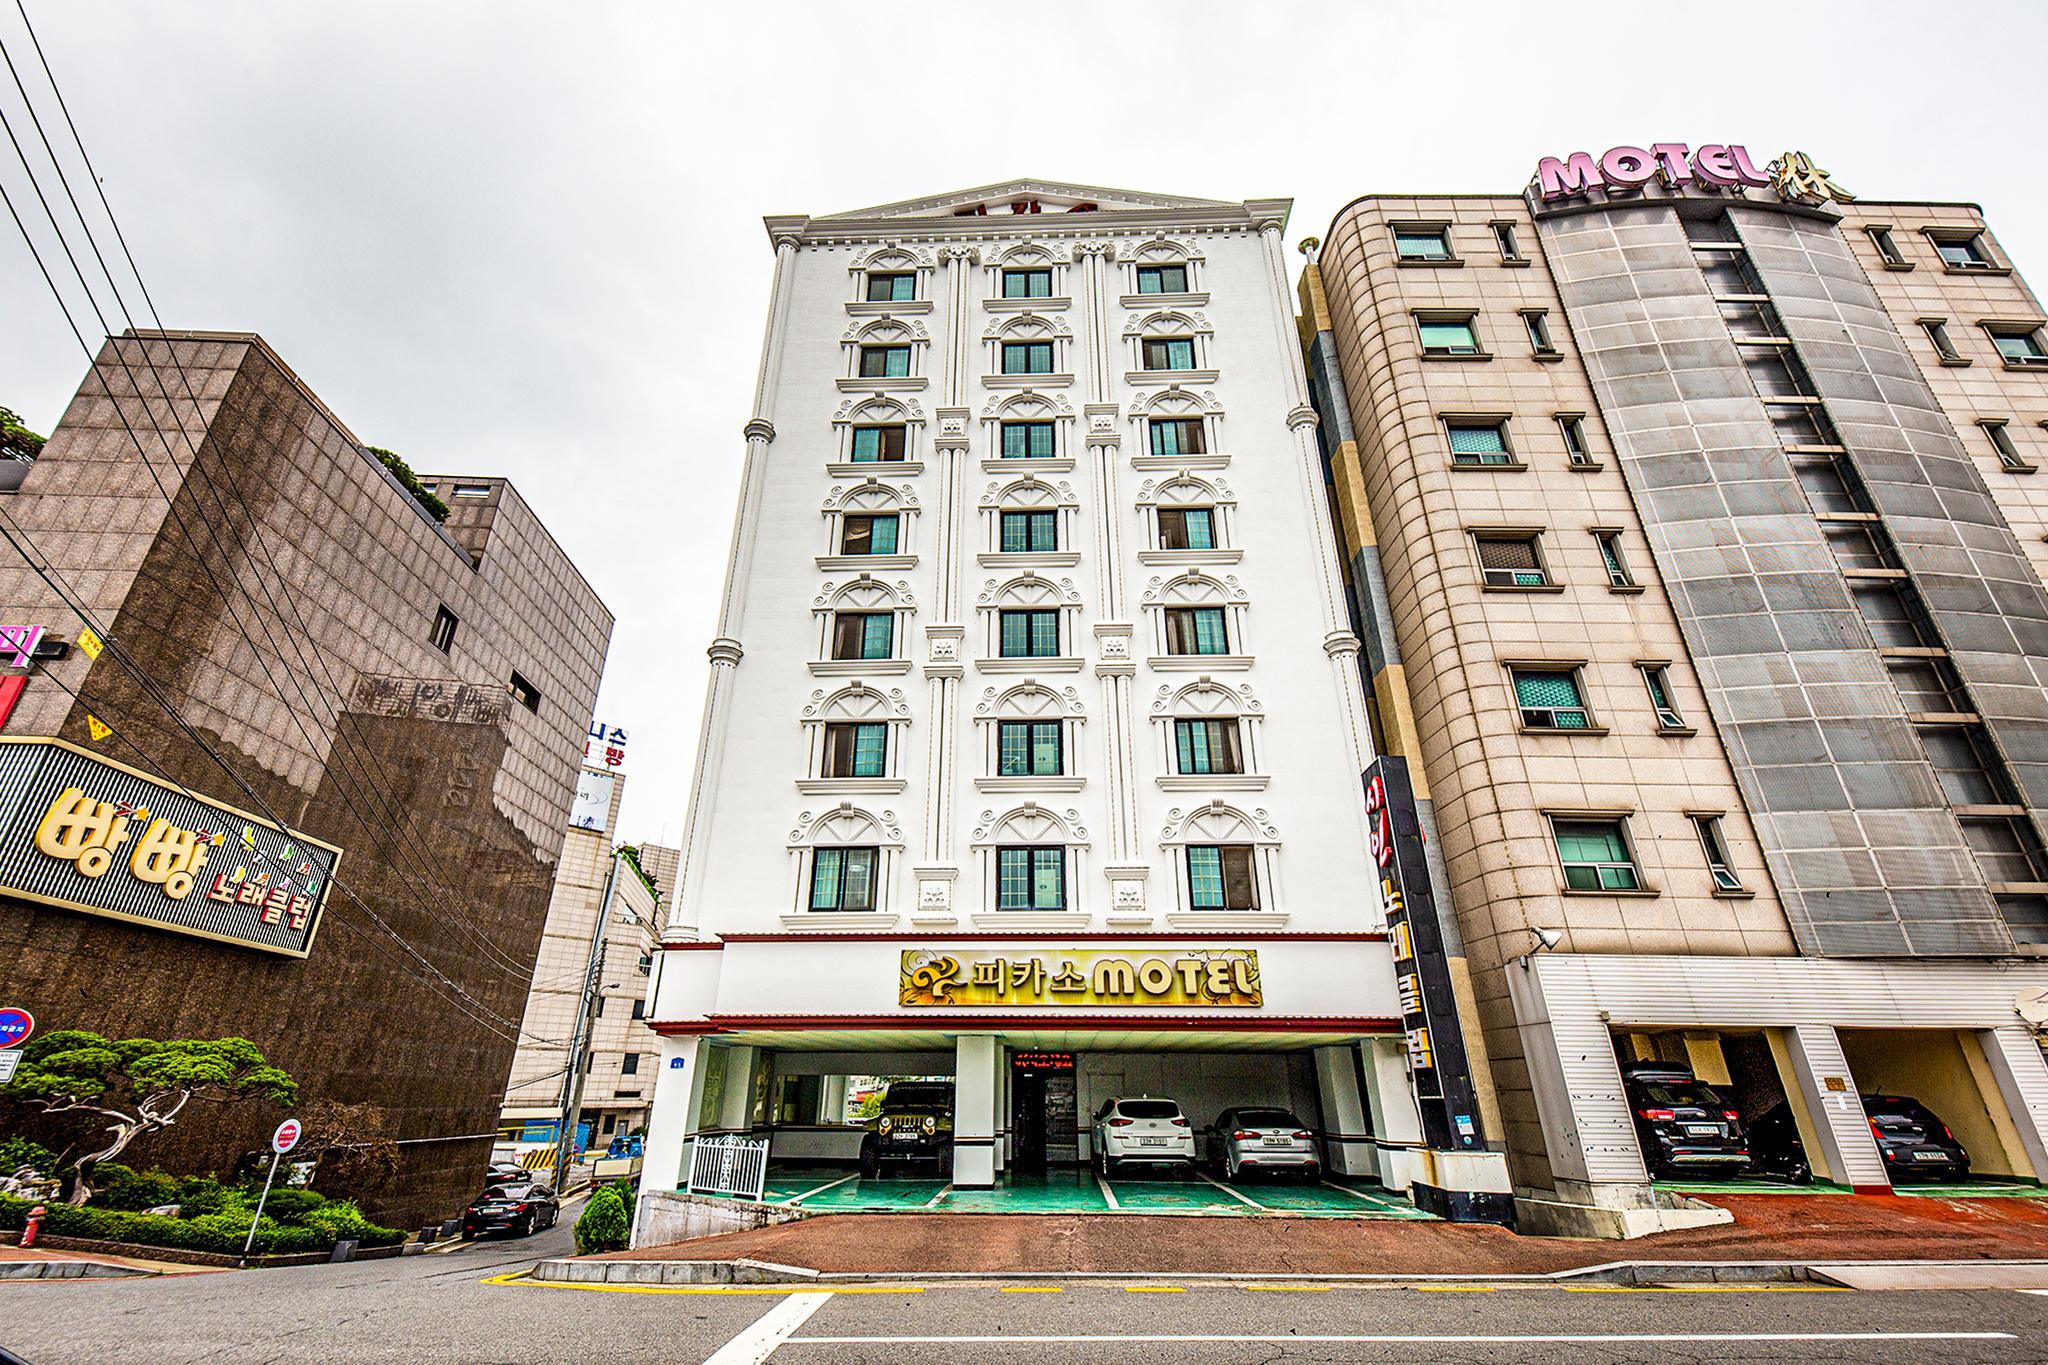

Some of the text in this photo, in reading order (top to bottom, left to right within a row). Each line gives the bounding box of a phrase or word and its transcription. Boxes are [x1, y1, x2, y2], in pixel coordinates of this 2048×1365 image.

[1538, 143, 1771, 200] MOTEL
[210, 873, 312, 930] 노래클럽
[973, 957, 1255, 995] 피카소 MOTEL
